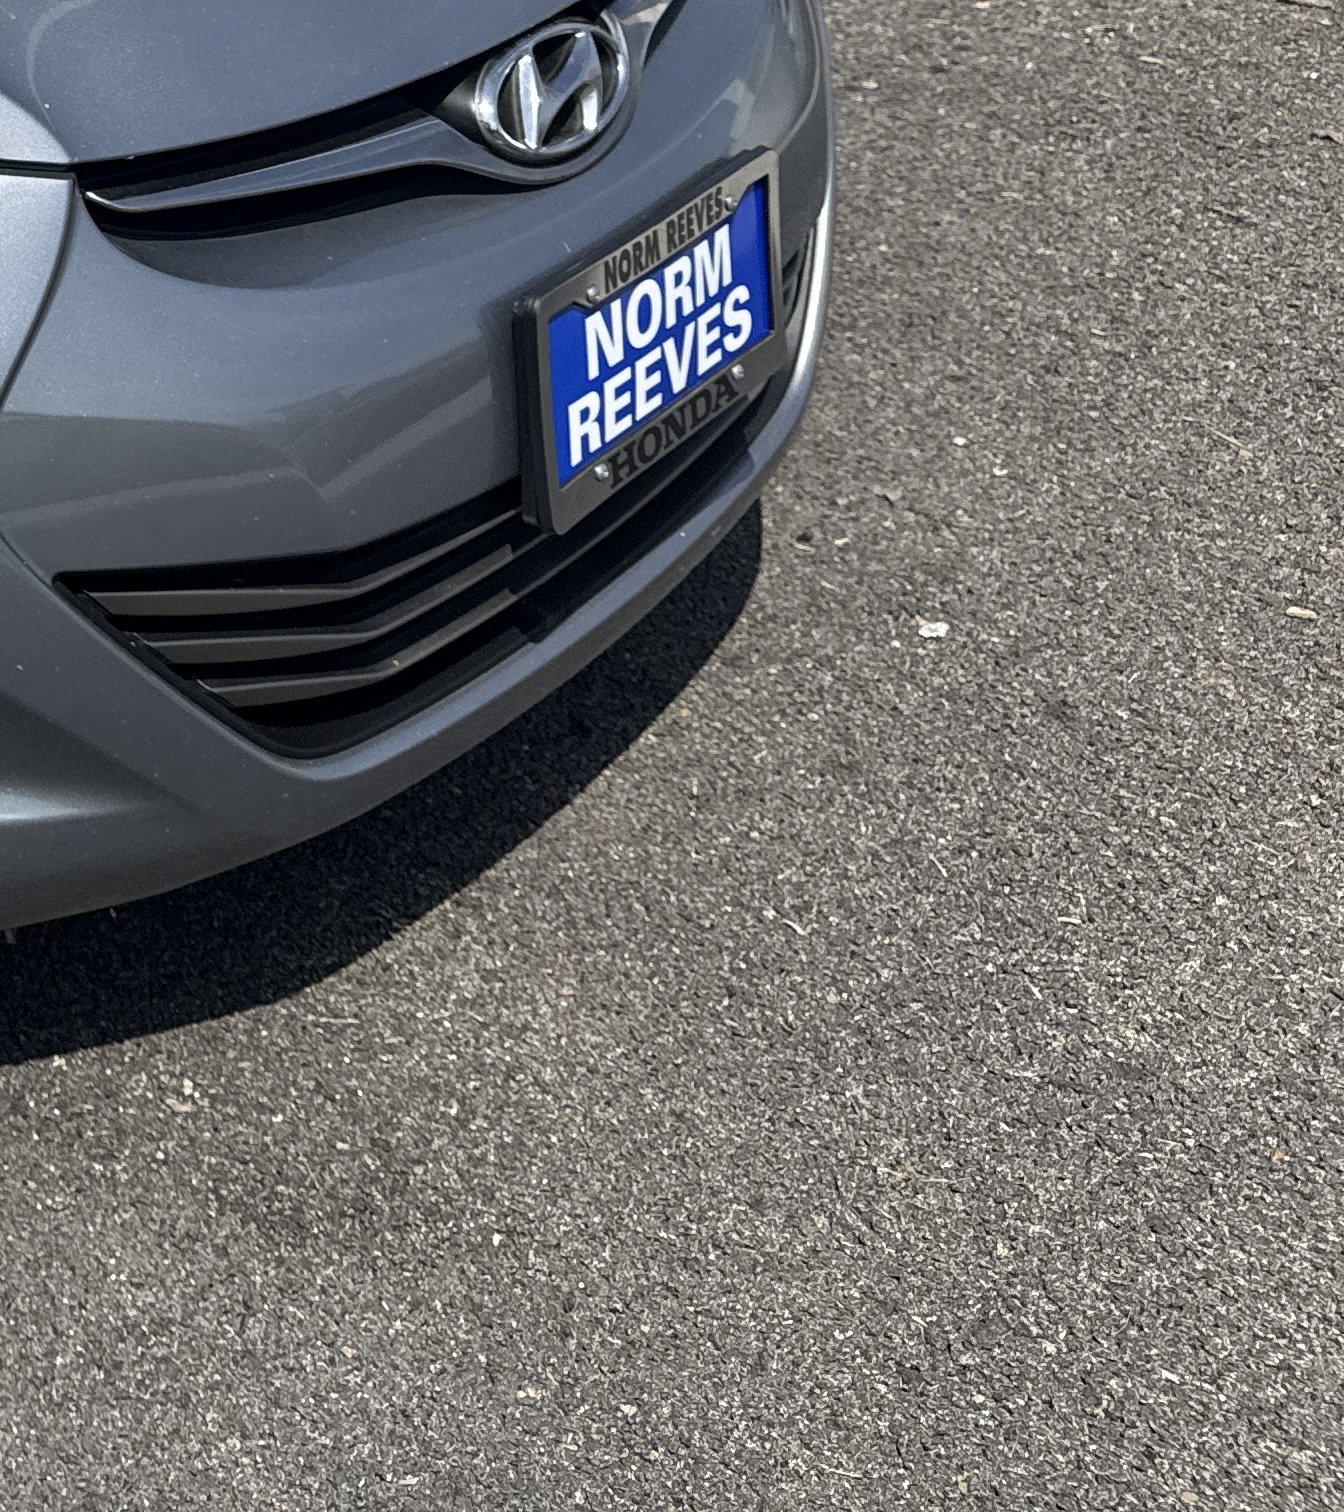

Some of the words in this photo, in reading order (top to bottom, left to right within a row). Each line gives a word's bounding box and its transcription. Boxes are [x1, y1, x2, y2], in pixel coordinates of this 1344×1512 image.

[584, 223, 733, 381] NORM
[603, 230, 661, 294] NORM
[666, 186, 723, 254] REEVES
[567, 284, 752, 467] REEVES
[609, 374, 740, 488] HONDA
